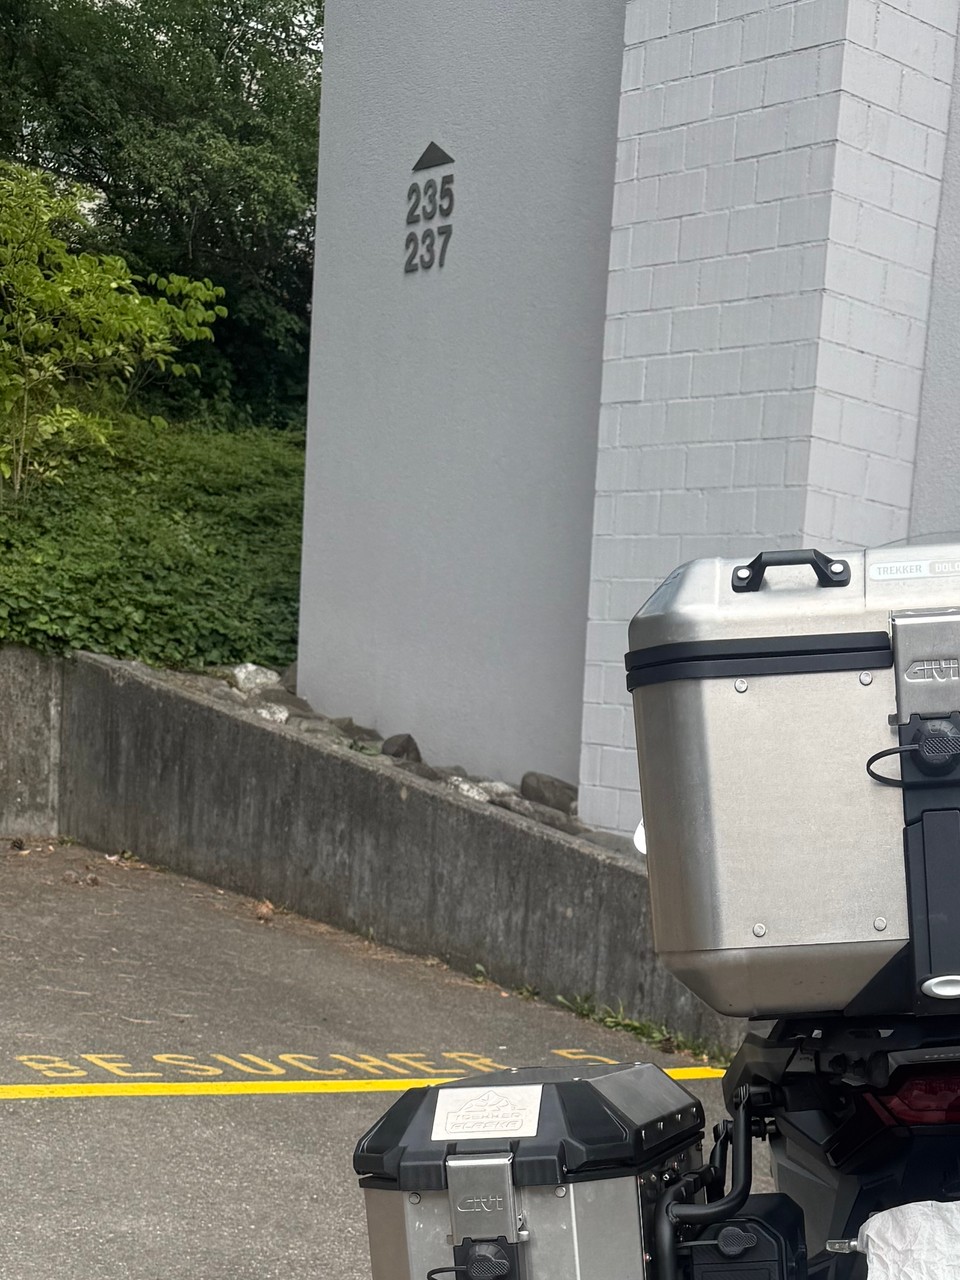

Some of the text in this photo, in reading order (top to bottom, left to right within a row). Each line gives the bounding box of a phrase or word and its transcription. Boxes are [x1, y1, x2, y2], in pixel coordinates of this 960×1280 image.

[406, 174, 454, 225] 235
[404, 224, 453, 273] 237
[876, 564, 923, 576] TREKKER
[904, 659, 960, 682] GIVI
[14, 1048, 621, 1078] BESUCHER 5
[456, 1194, 504, 1212] GIVI
